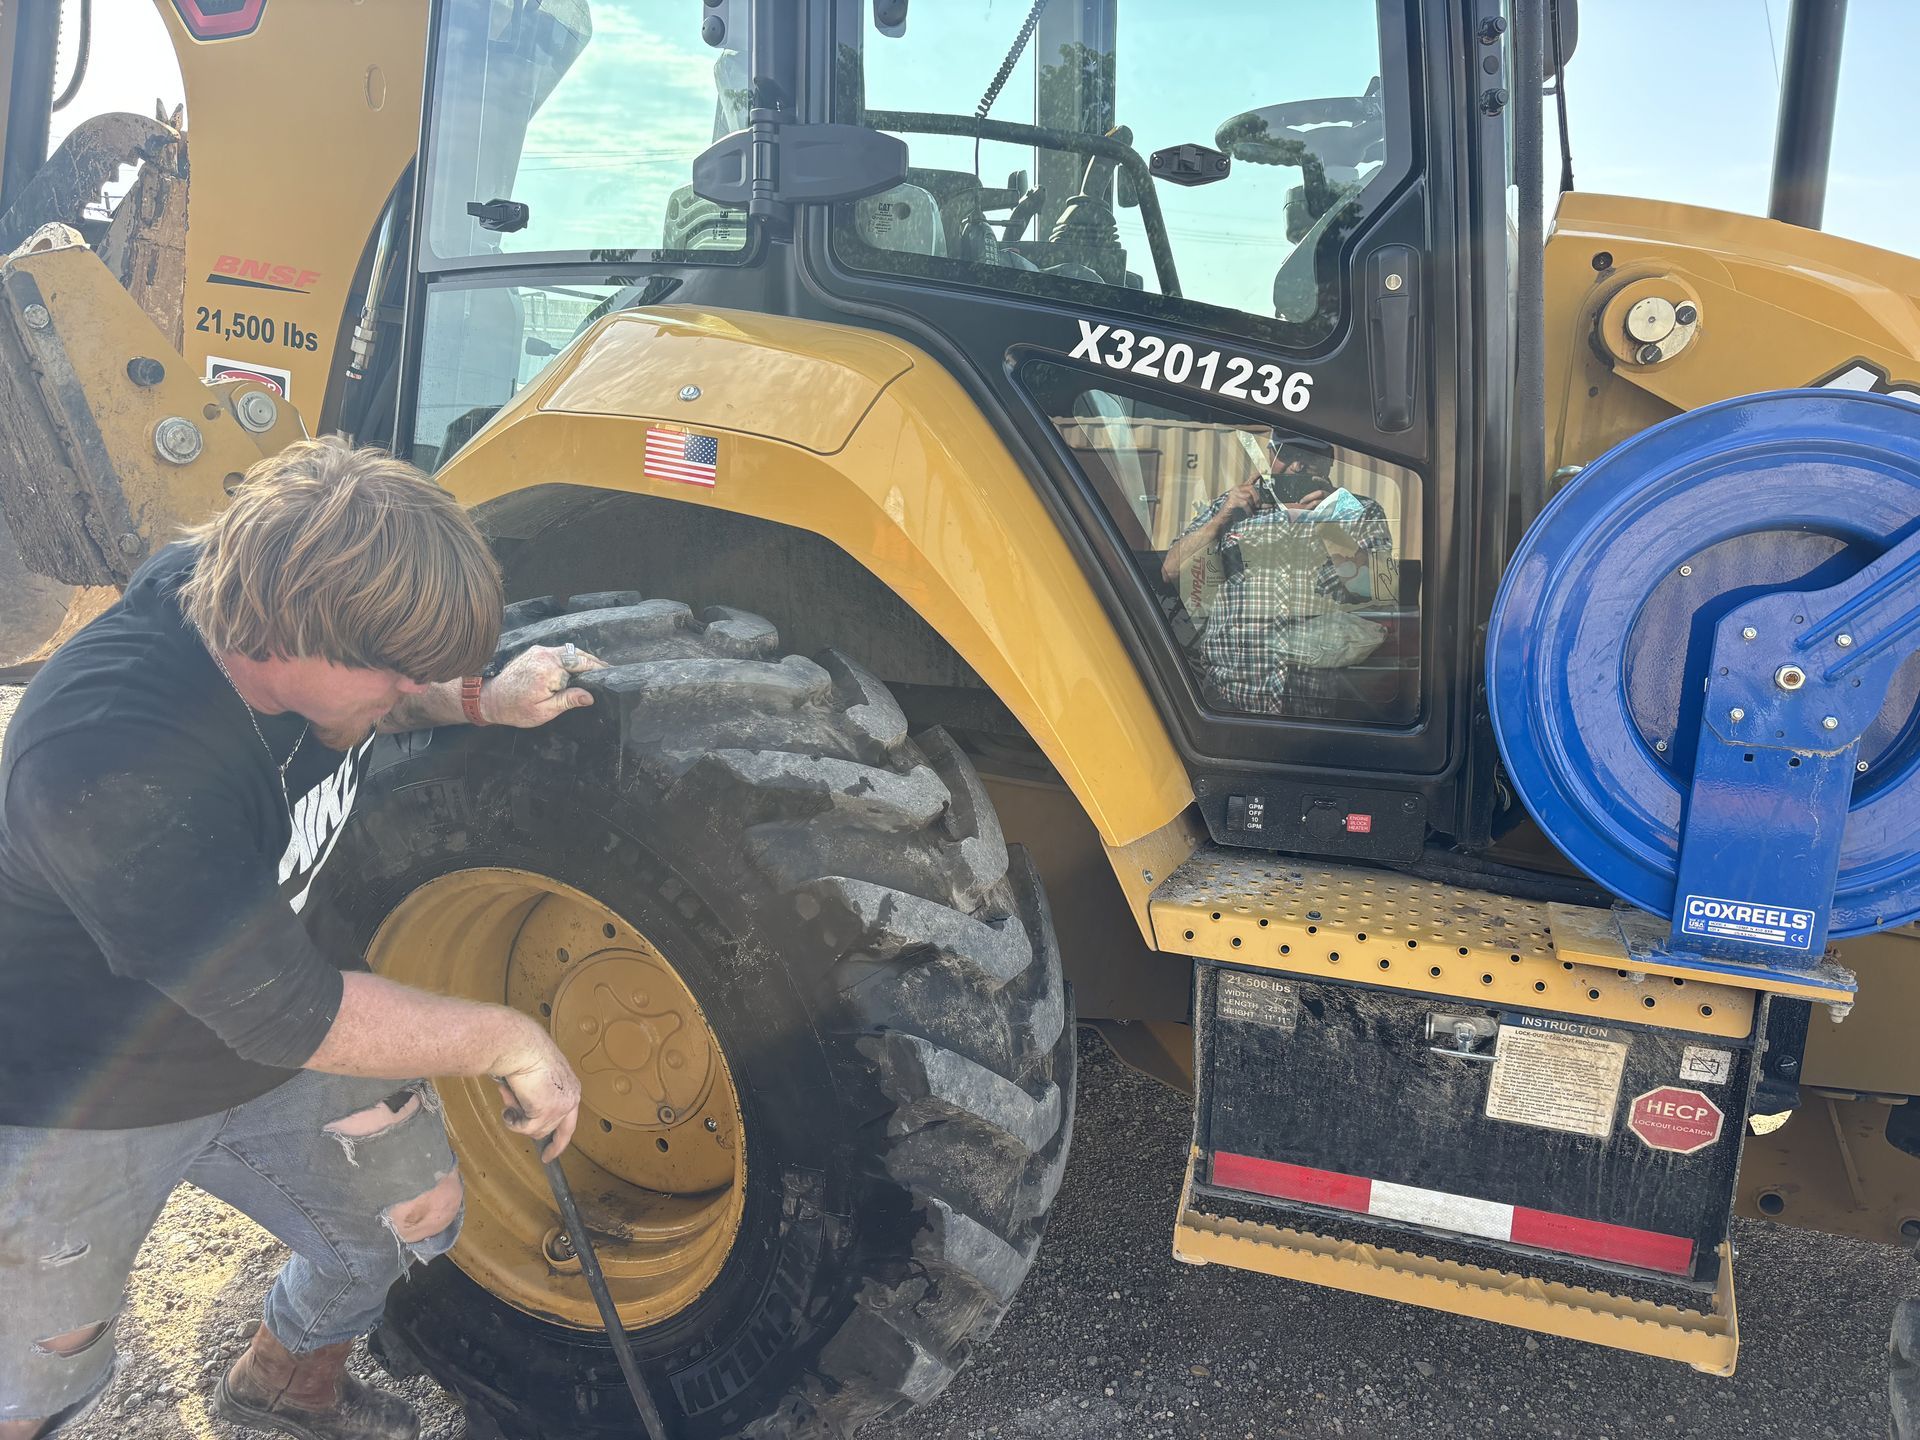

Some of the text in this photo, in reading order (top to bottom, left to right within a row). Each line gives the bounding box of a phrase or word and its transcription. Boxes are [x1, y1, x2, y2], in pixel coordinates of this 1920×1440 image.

[212, 254, 321, 289] BNSF
[196, 306, 319, 352] 21,500 lbs
[1067, 319, 1314, 413] X3201236
[277, 744, 358, 886] NIKE
[1689, 900, 1808, 930] COXREELS
[1224, 988, 1252, 998] WIDTH
[1272, 982, 1291, 993] lbs
[1223, 998, 1258, 1009] LENGTH
[1223, 1007, 1254, 1018] HEIGHT
[1521, 1016, 1609, 1038] INSTRUCTION
[1515, 1029, 1544, 1039] LOCK-OUT
[1575, 1039, 1610, 1049] PROCEDURE
[1646, 1100, 1708, 1121] HECP
[1634, 1119, 1714, 1137] LOCKOUT LOCATION
